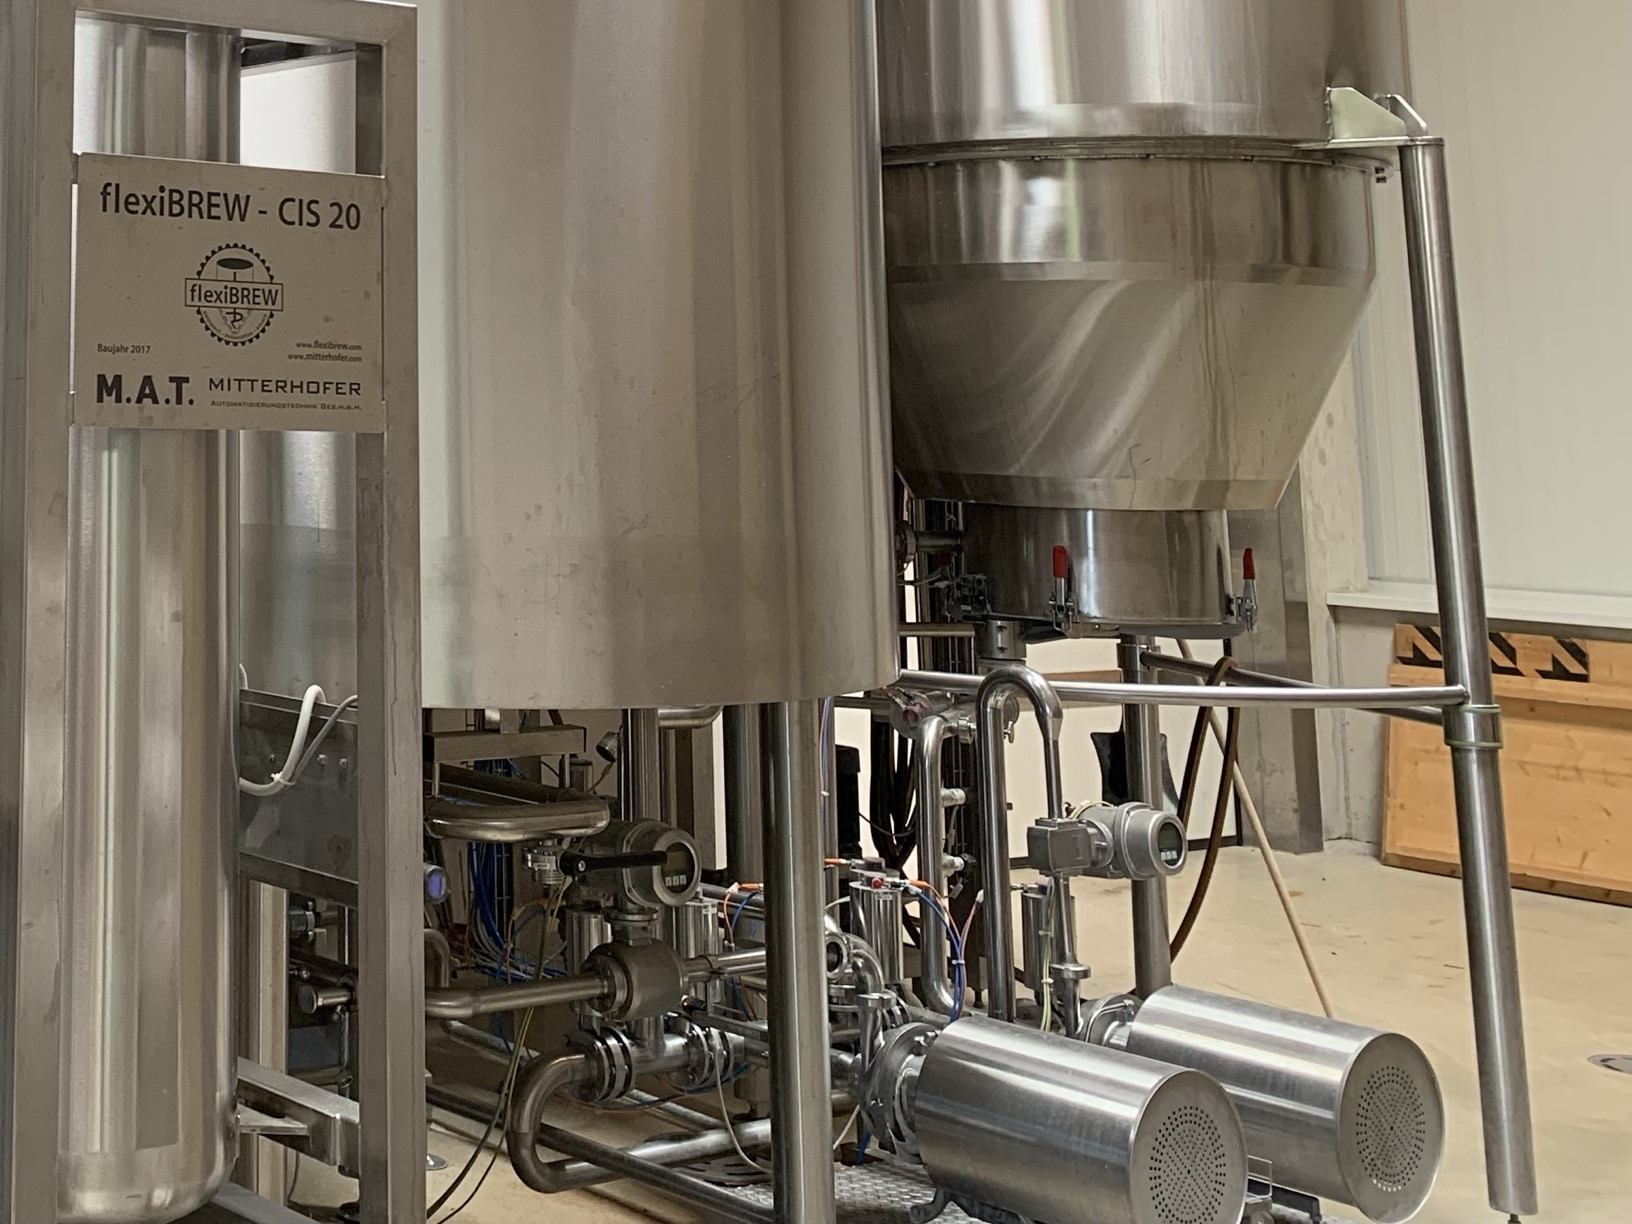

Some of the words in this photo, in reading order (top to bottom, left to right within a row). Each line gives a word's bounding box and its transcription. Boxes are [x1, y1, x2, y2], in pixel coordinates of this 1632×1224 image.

[99, 182, 252, 223] flexiBREW
[278, 197, 321, 228] CIS
[328, 201, 362, 231] 20
[189, 283, 279, 307] flexiBREW
[96, 343, 129, 355] Baujahr
[130, 344, 152, 354] 2017
[296, 340, 363, 351] www.flexibrew.com
[287, 352, 363, 363] www.mitterhofer.com
[96, 373, 195, 406] M.A.T.
[208, 377, 362, 396] MITTERHOFER
